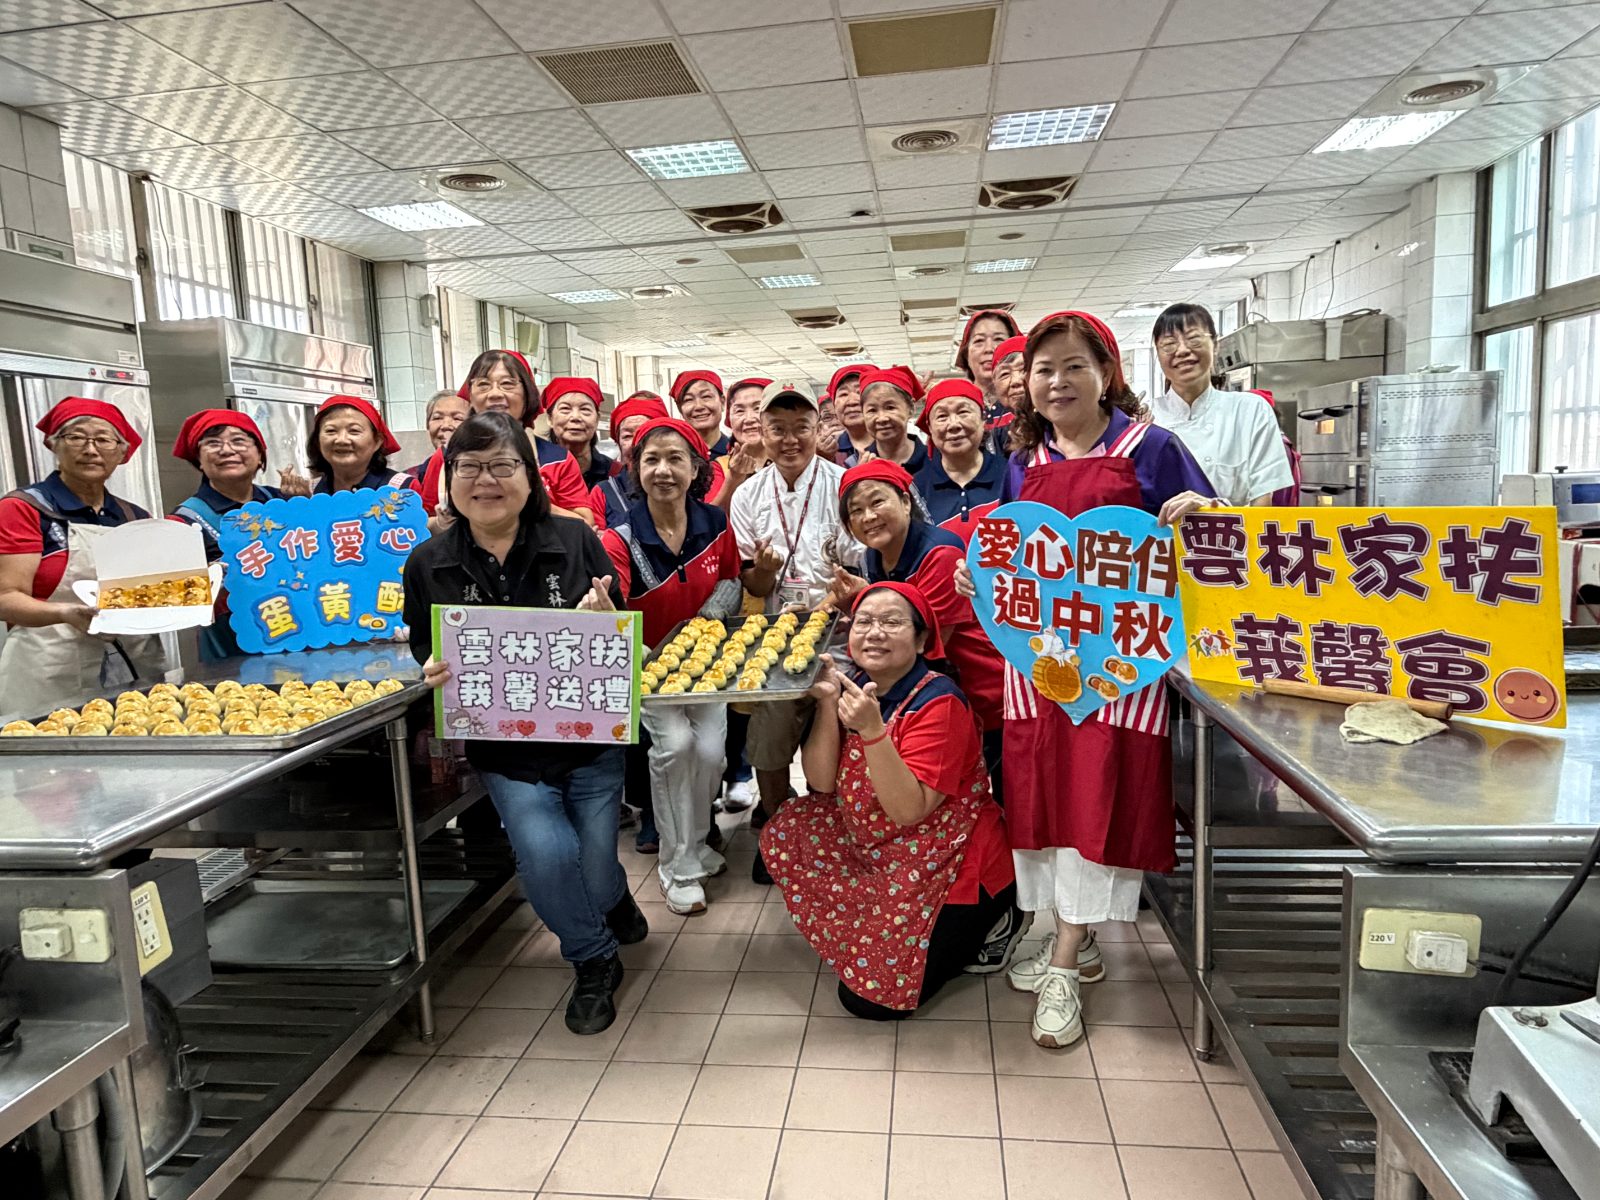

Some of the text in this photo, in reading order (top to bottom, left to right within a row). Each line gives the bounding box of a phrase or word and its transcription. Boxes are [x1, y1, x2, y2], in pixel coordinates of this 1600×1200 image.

[236, 520, 416, 578] 手作愛心
[977, 517, 1178, 598] 愛心陪伴
[1179, 512, 1543, 607] 雲林家扶
[457, 627, 629, 671] 雲林家扶
[994, 574, 1173, 661] 過中秋
[458, 670, 630, 713] 莪馨送禮
[1231, 612, 1491, 713] 莪馨會
